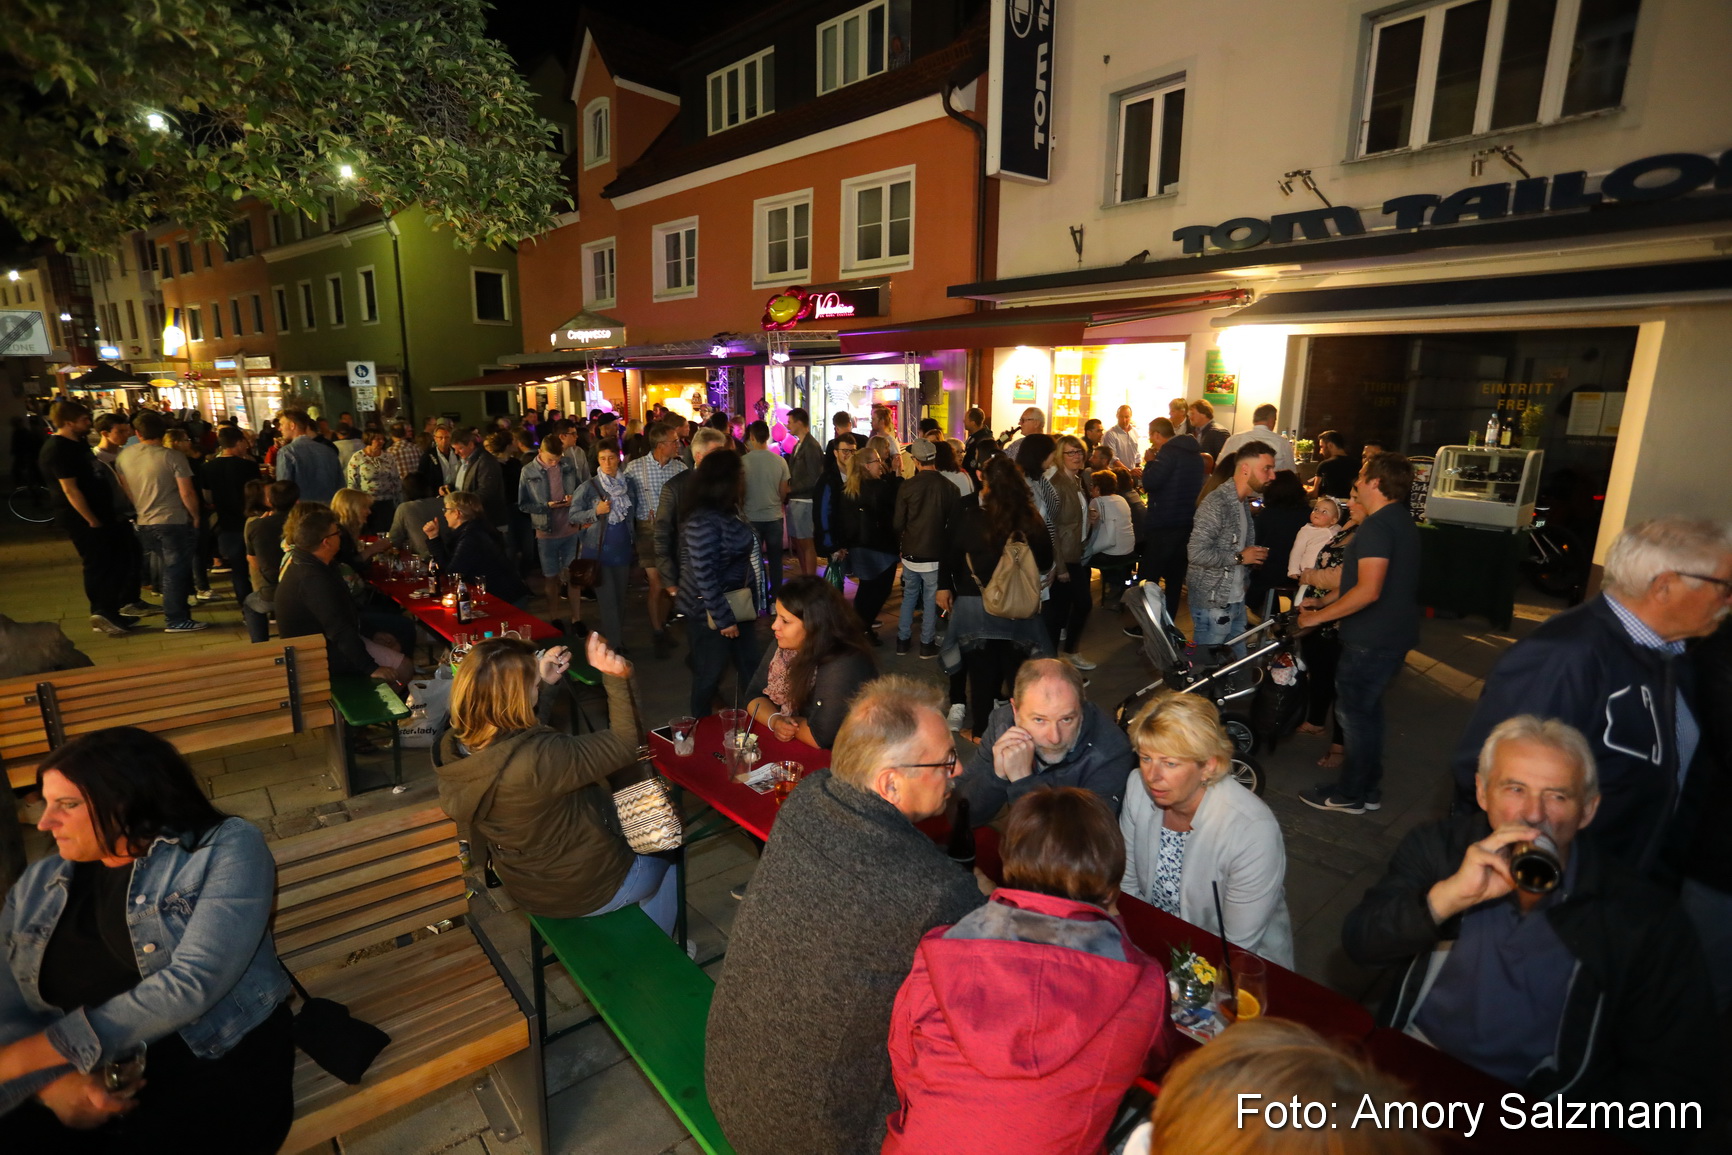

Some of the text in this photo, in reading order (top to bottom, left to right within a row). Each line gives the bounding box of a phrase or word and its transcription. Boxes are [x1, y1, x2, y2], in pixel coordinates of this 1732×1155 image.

[1033, 41, 1049, 150] TOM
[1172, 205, 1366, 254] TOM
[1481, 383, 1554, 395] EINTRITT
